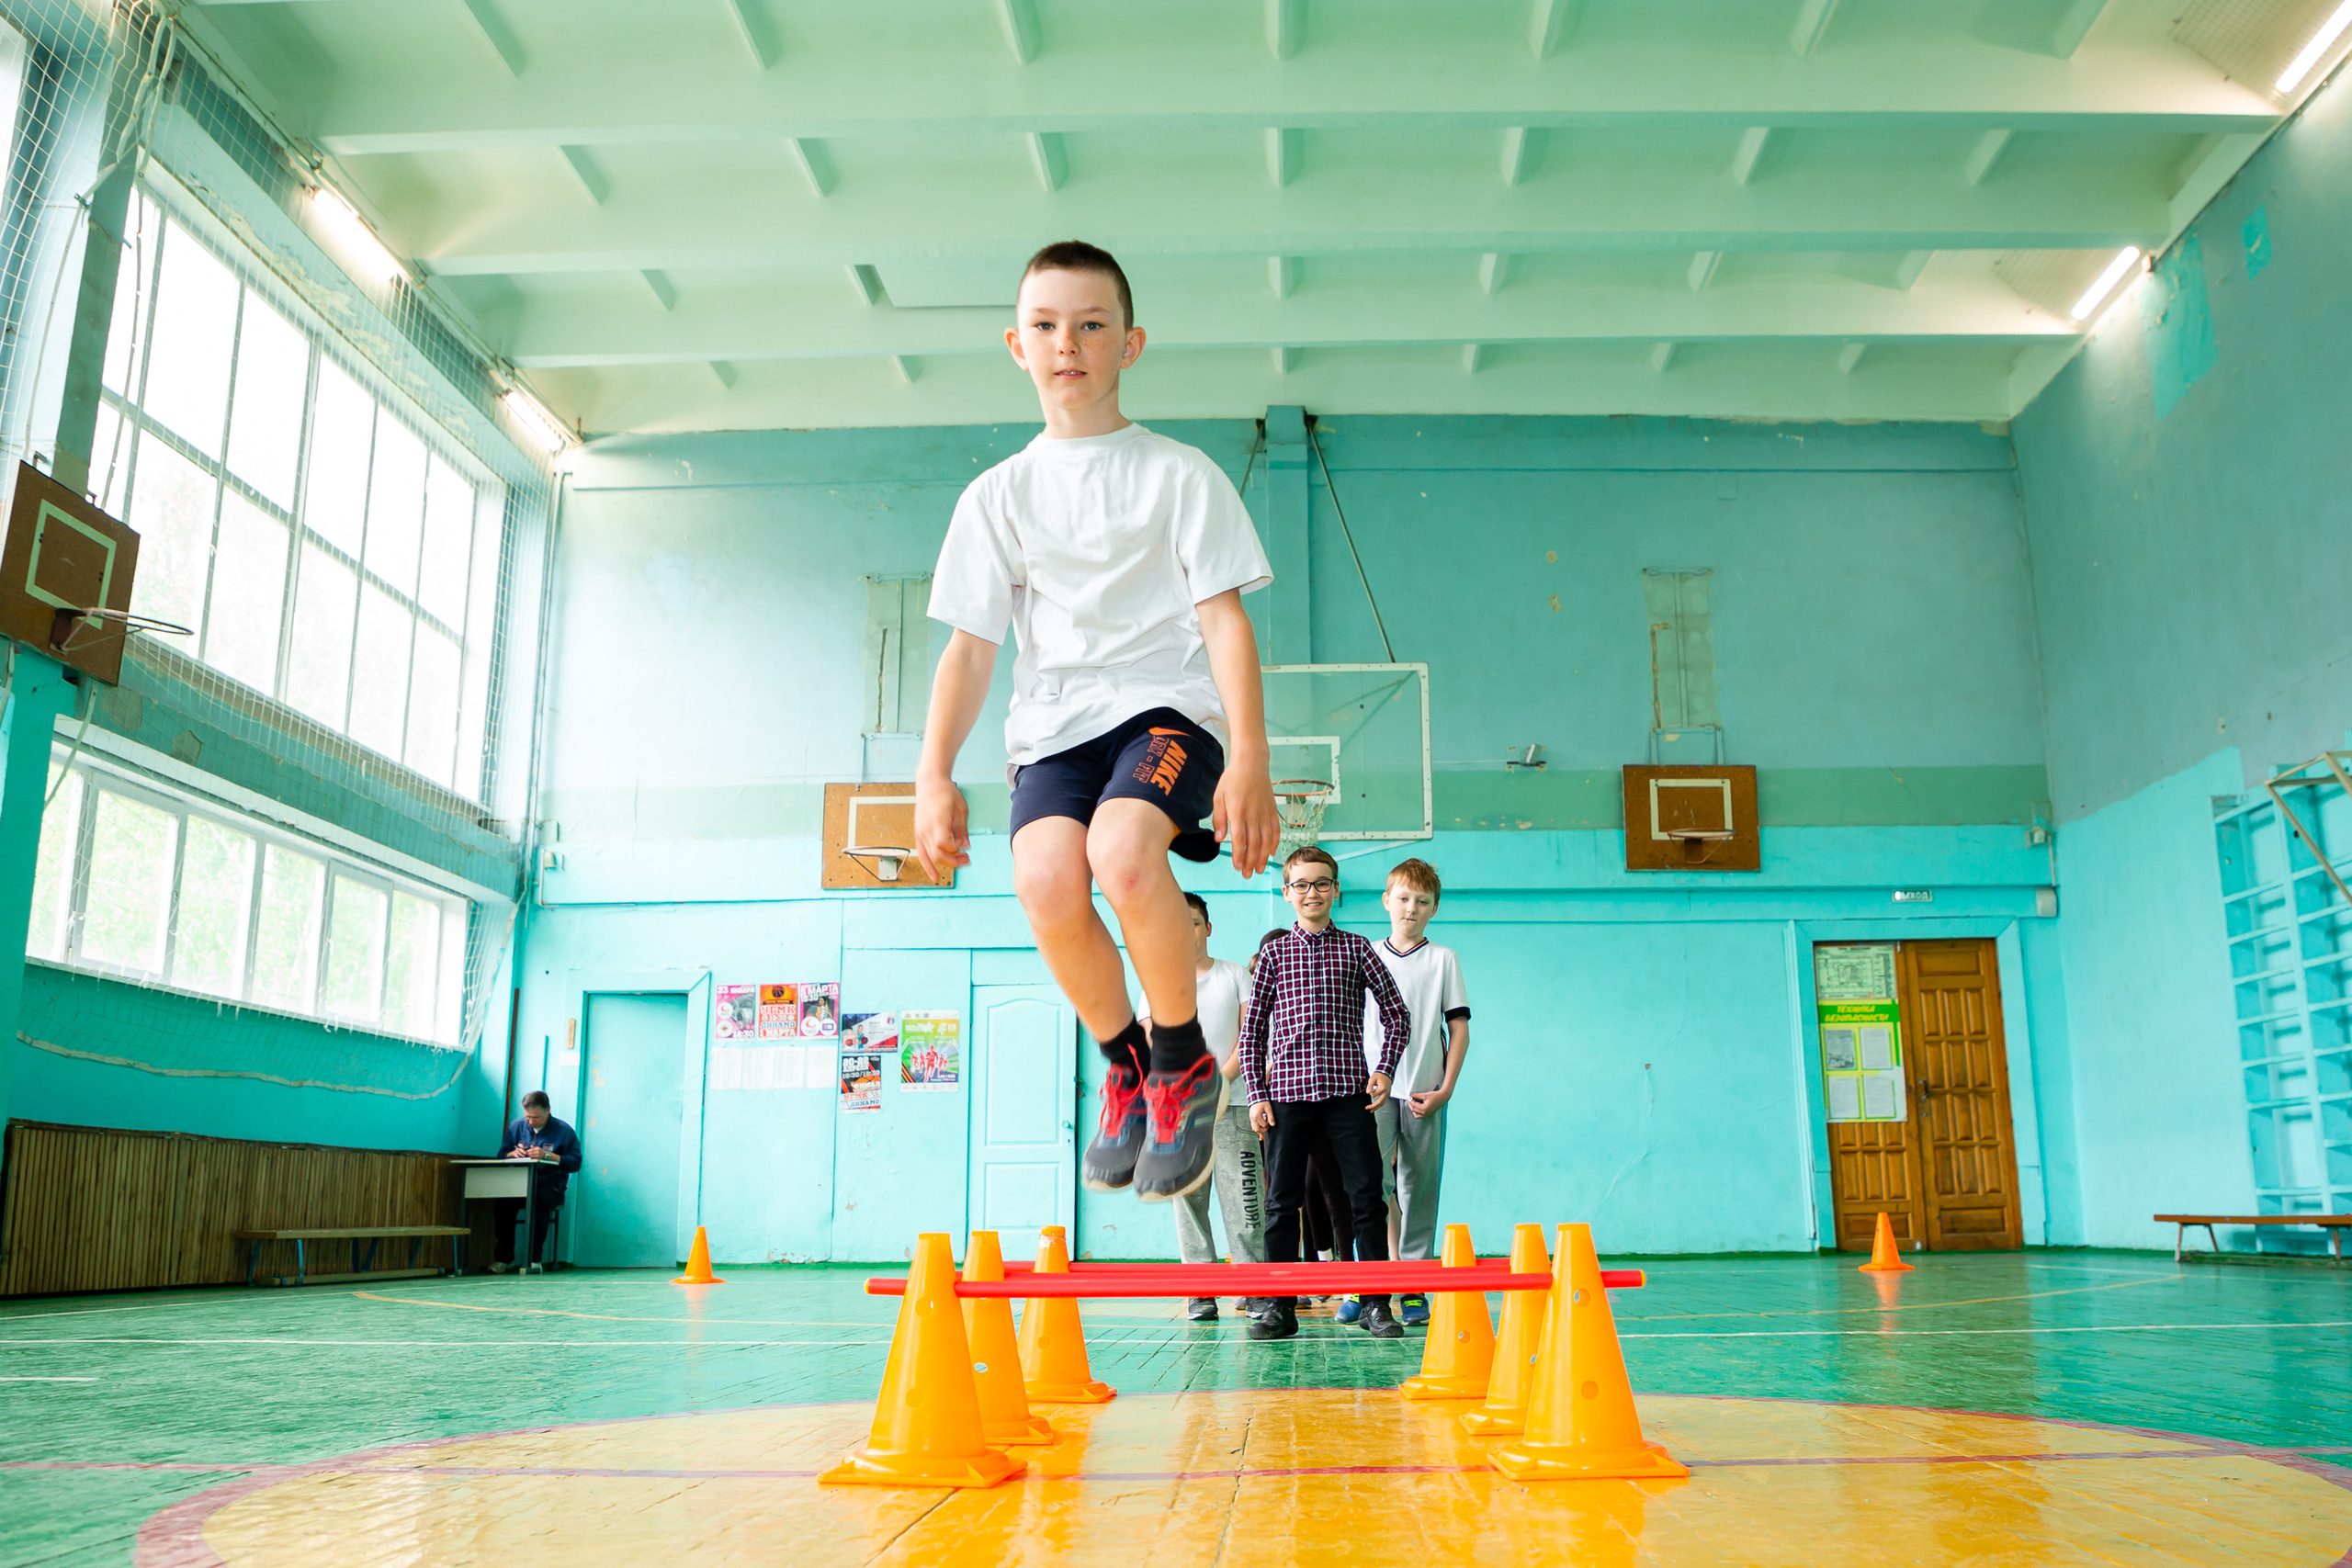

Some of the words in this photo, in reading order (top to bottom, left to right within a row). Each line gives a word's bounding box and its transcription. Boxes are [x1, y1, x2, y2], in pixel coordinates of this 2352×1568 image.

[1149, 739, 1188, 796] NIKE
[717, 986, 729, 994] 23
[808, 983, 839, 995] МАРТА
[761, 1005, 796, 1015] УГМК
[1837, 1005, 1875, 1013] ТЕХНИКА
[1825, 1013, 1890, 1022] БЕЗОПАСНОСТИ
[765, 1028, 796, 1037] МАРТА
[843, 1091, 868, 1100] УГМК
[850, 1099, 880, 1108] ДИНАМО
[1239, 1150, 1261, 1229] ADVENTURE
